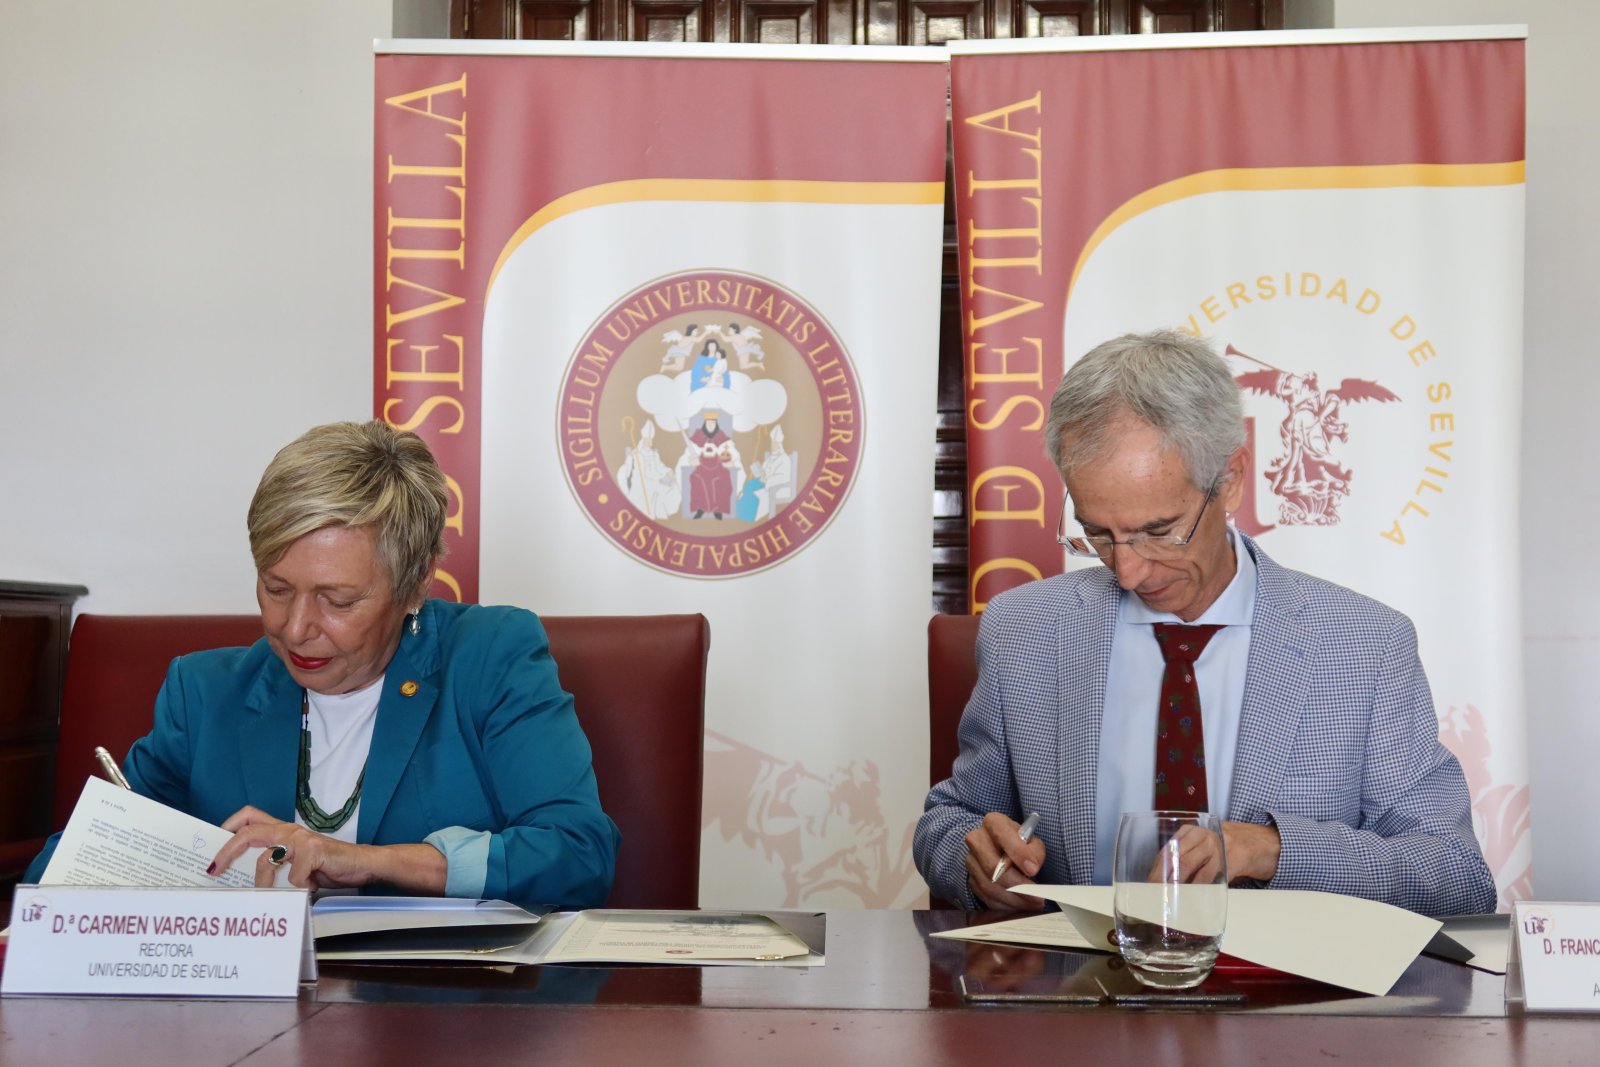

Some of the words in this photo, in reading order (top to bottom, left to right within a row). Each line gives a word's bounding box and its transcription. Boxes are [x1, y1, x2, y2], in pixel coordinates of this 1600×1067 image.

[383, 72, 467, 433] SEVILLA
[965, 90, 1045, 431] SEVILLA
[606, 279, 817, 344] UNIVERSITATIS
[1178, 272, 1382, 337] VERSIDAD
[1389, 314, 1437, 367] DE
[568, 340, 614, 486] SIGILLUM
[788, 341, 853, 535] LITTERARIAE
[1380, 382, 1455, 546] SEVILLA
[609, 508, 792, 570] HISPALENSIS
[78, 914, 148, 934] CARMEN
[153, 915, 220, 936] VARGAS
[224, 912, 287, 937] MACÍAS
[139, 943, 194, 957] RECTORA
[1543, 938, 1555, 955] D.
[88, 963, 168, 978] UNIVERSIDAD
[171, 963, 188, 978] DE
[191, 964, 239, 979] SEVILLA
